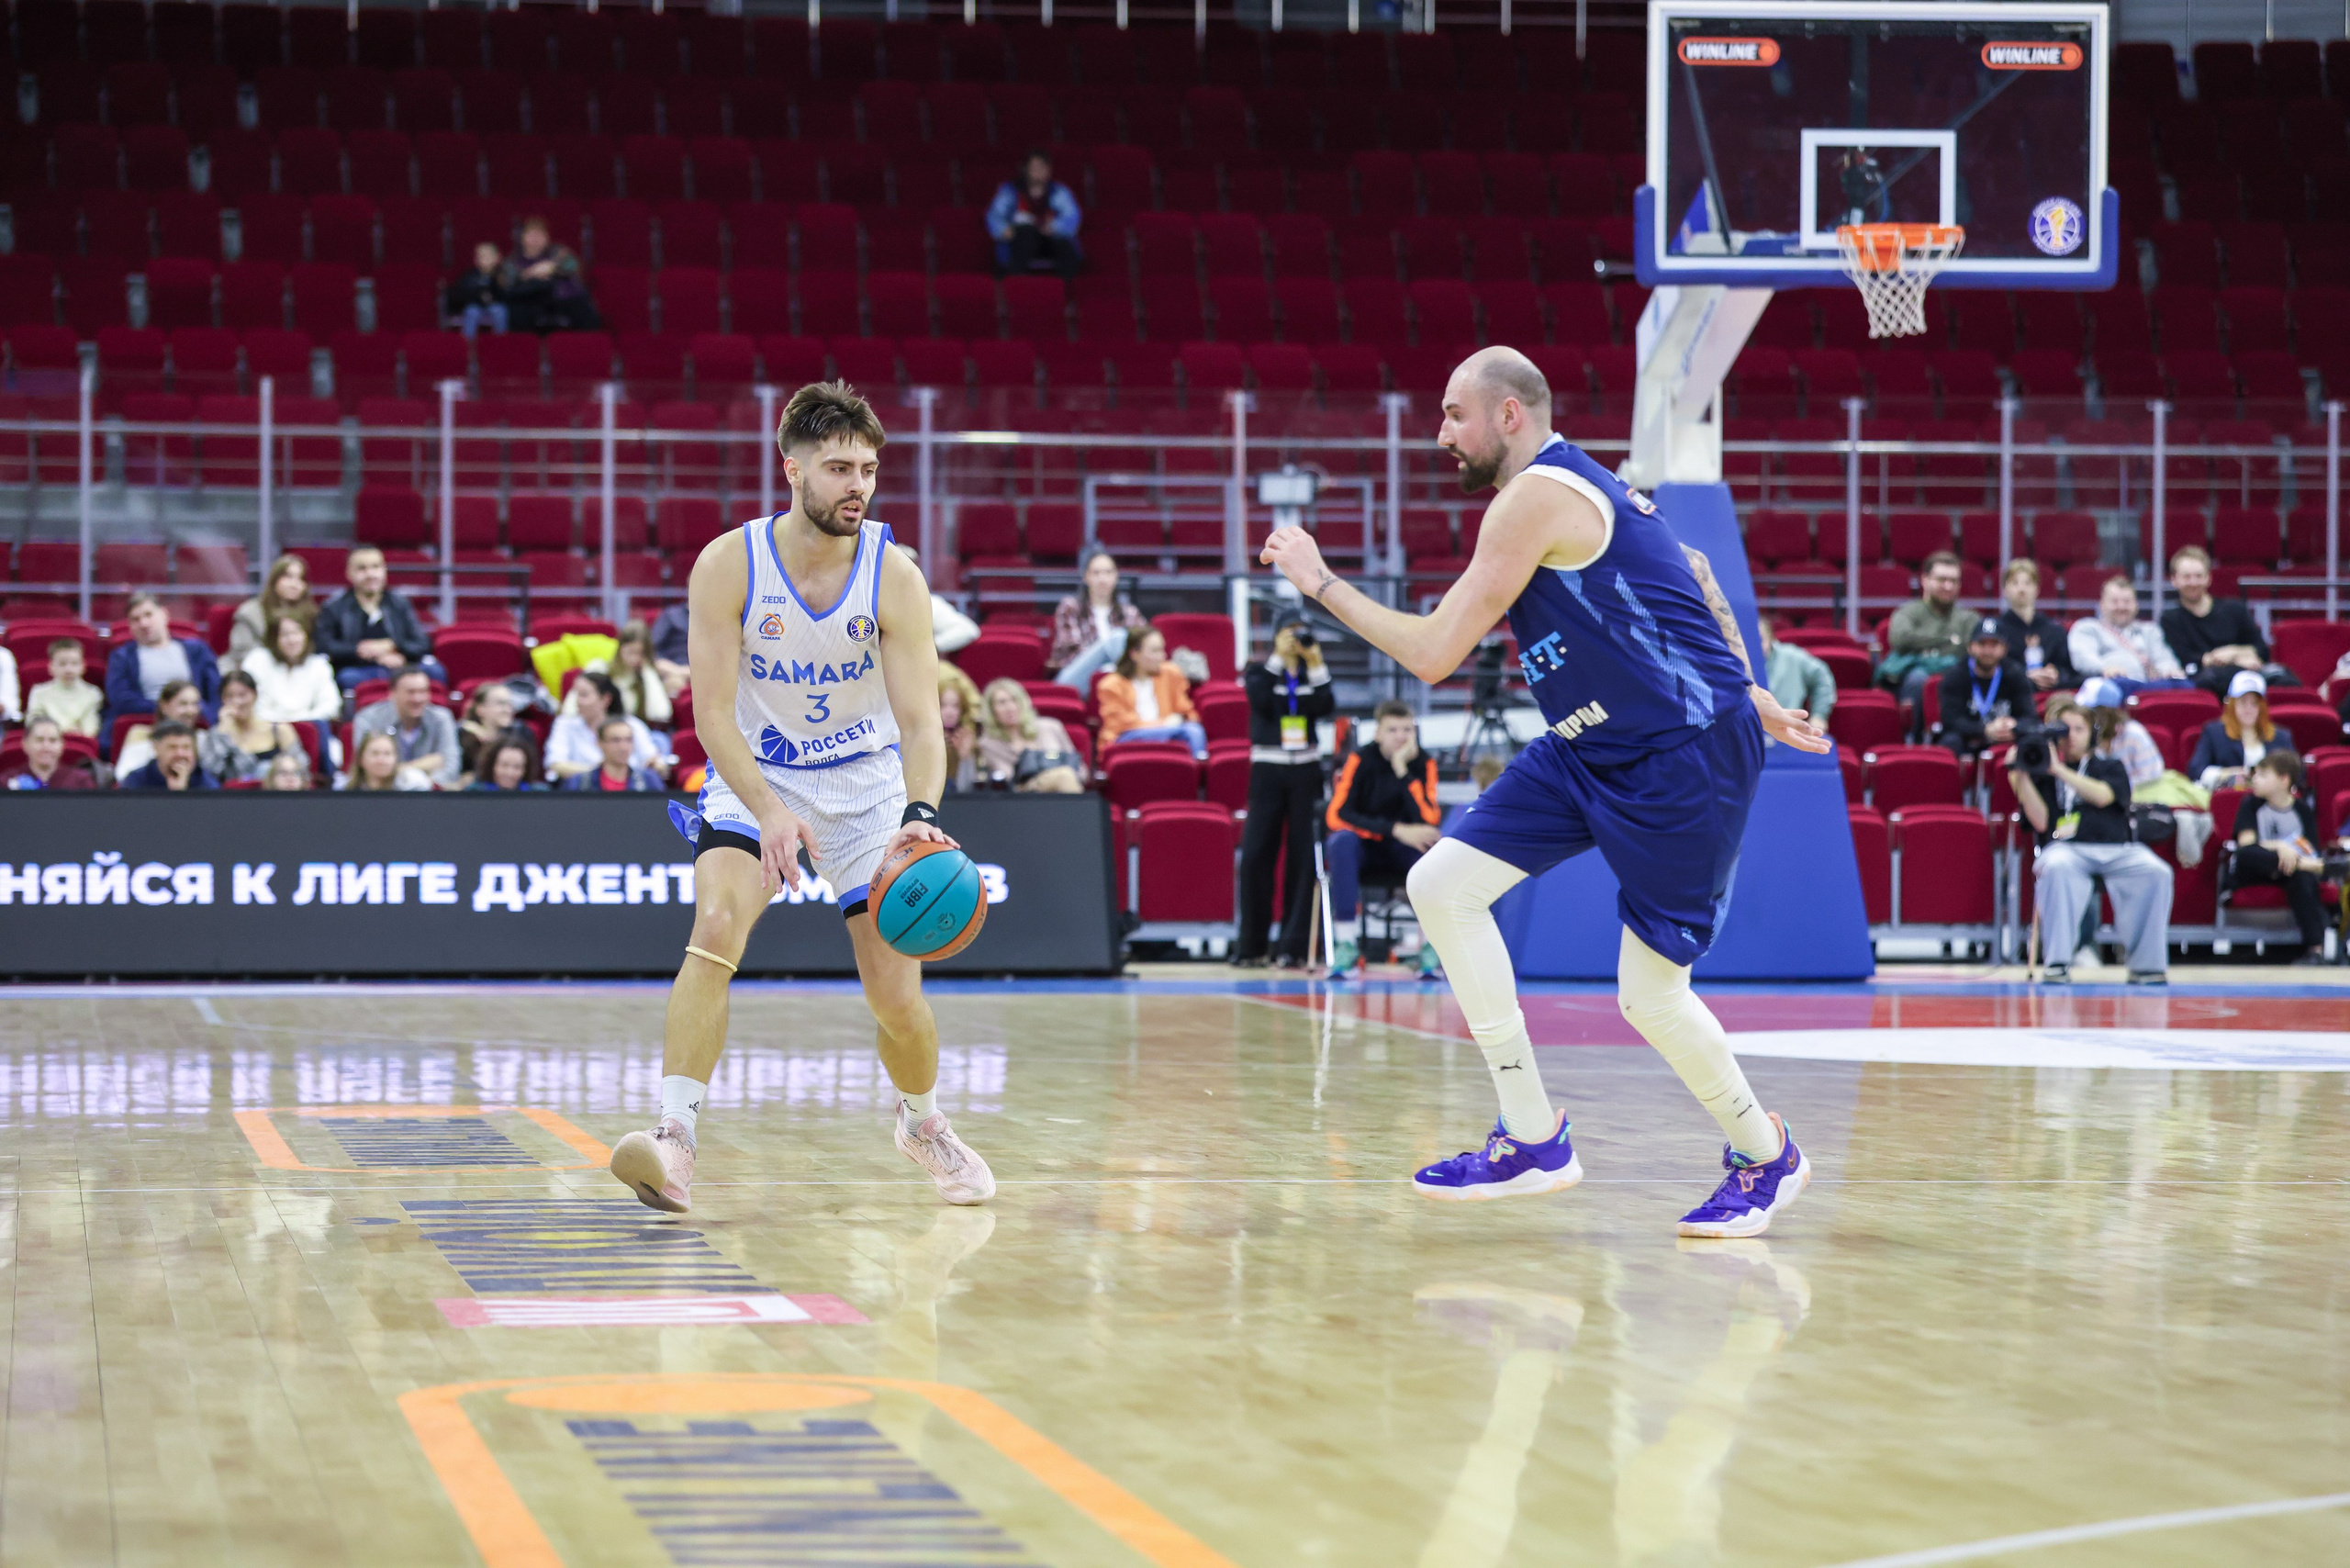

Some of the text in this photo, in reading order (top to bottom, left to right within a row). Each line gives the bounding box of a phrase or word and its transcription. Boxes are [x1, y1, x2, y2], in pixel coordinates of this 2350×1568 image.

[1686, 42, 1759, 60] WINLINE
[1989, 47, 2062, 64] WINLINE
[750, 650, 875, 685] SAMARA
[804, 693, 831, 723] 3
[800, 718, 877, 756] РОССЕТИ
[0, 851, 214, 906] НЯЙСЯ
[232, 862, 277, 905] К
[292, 862, 459, 906] ЛИГЕ
[904, 882, 929, 908] FIBA
